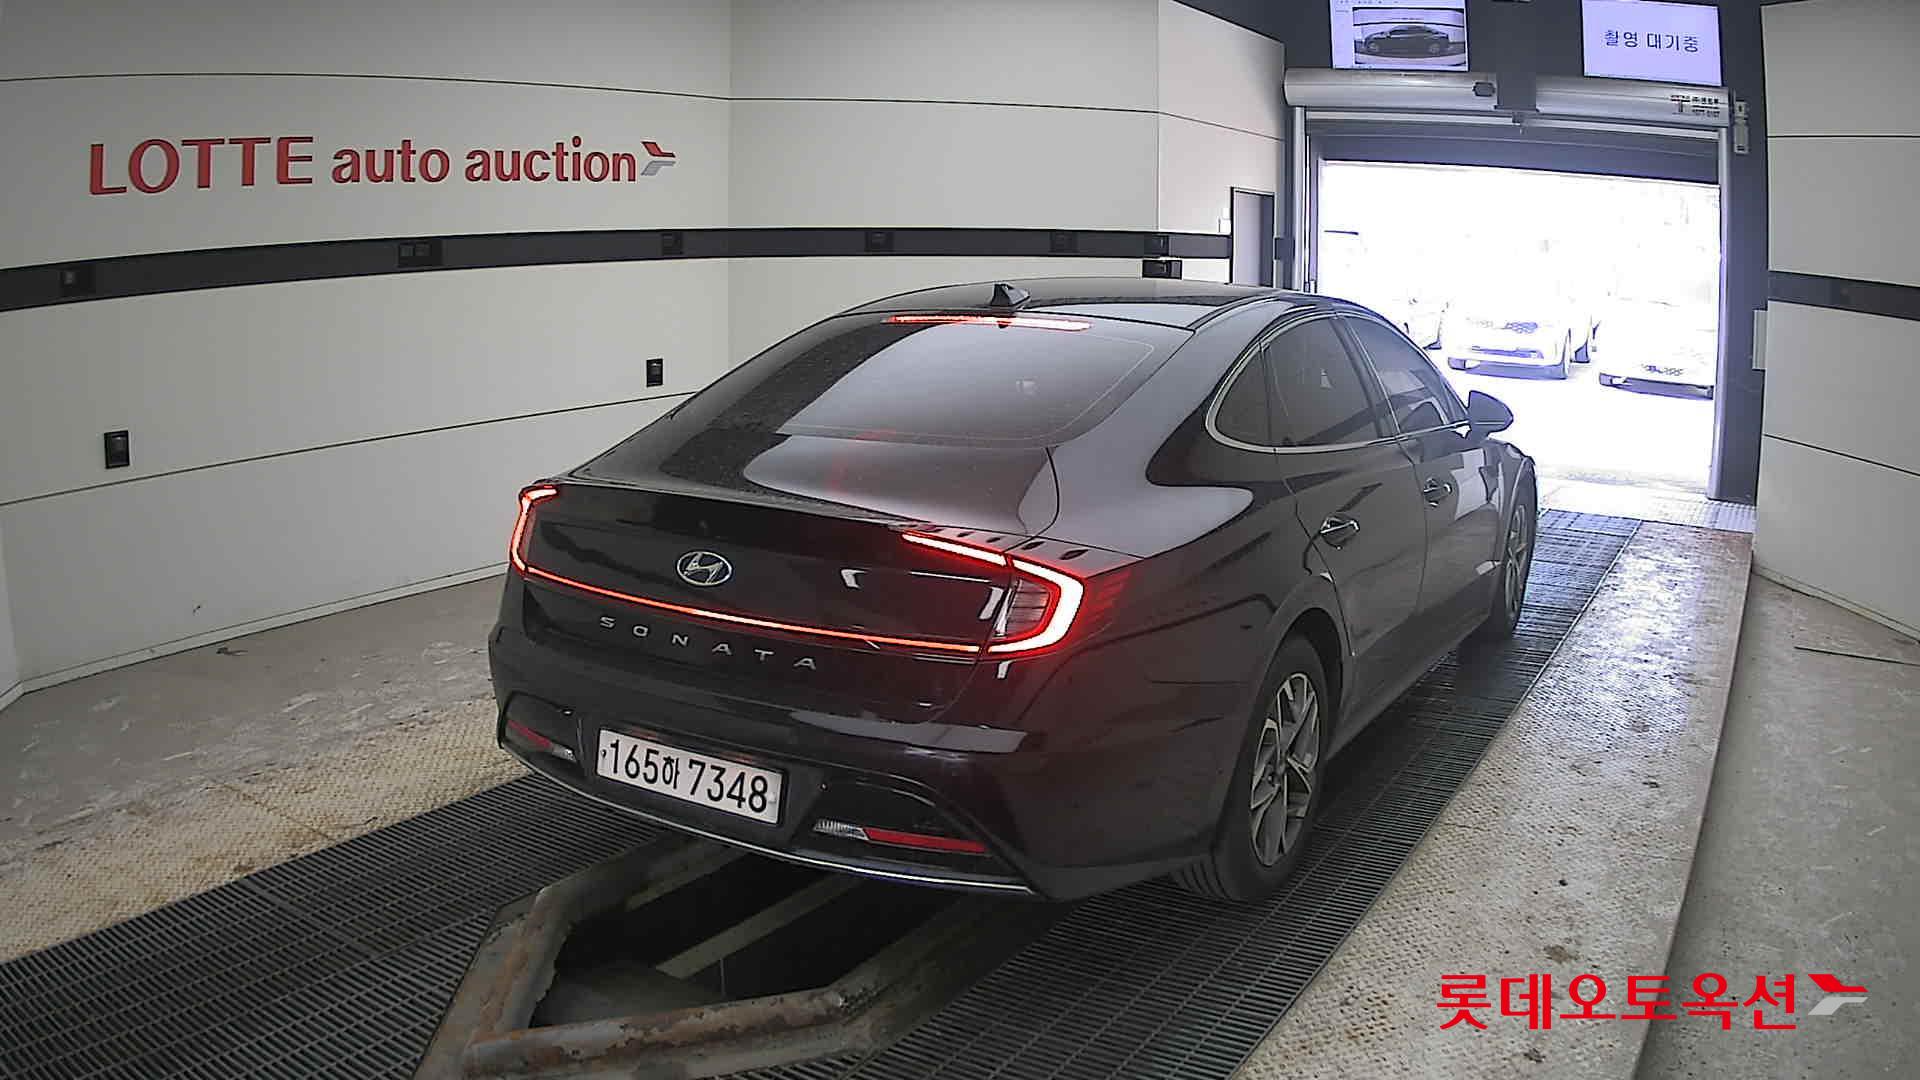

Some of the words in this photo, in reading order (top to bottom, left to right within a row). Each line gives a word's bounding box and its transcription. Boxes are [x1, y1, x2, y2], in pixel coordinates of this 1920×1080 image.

[1647, 32, 1699, 53] 대기중
[90, 136, 313, 195] LOTTE
[332, 139, 450, 184] auto
[465, 136, 637, 183] auction
[600, 616, 817, 670] SONATA
